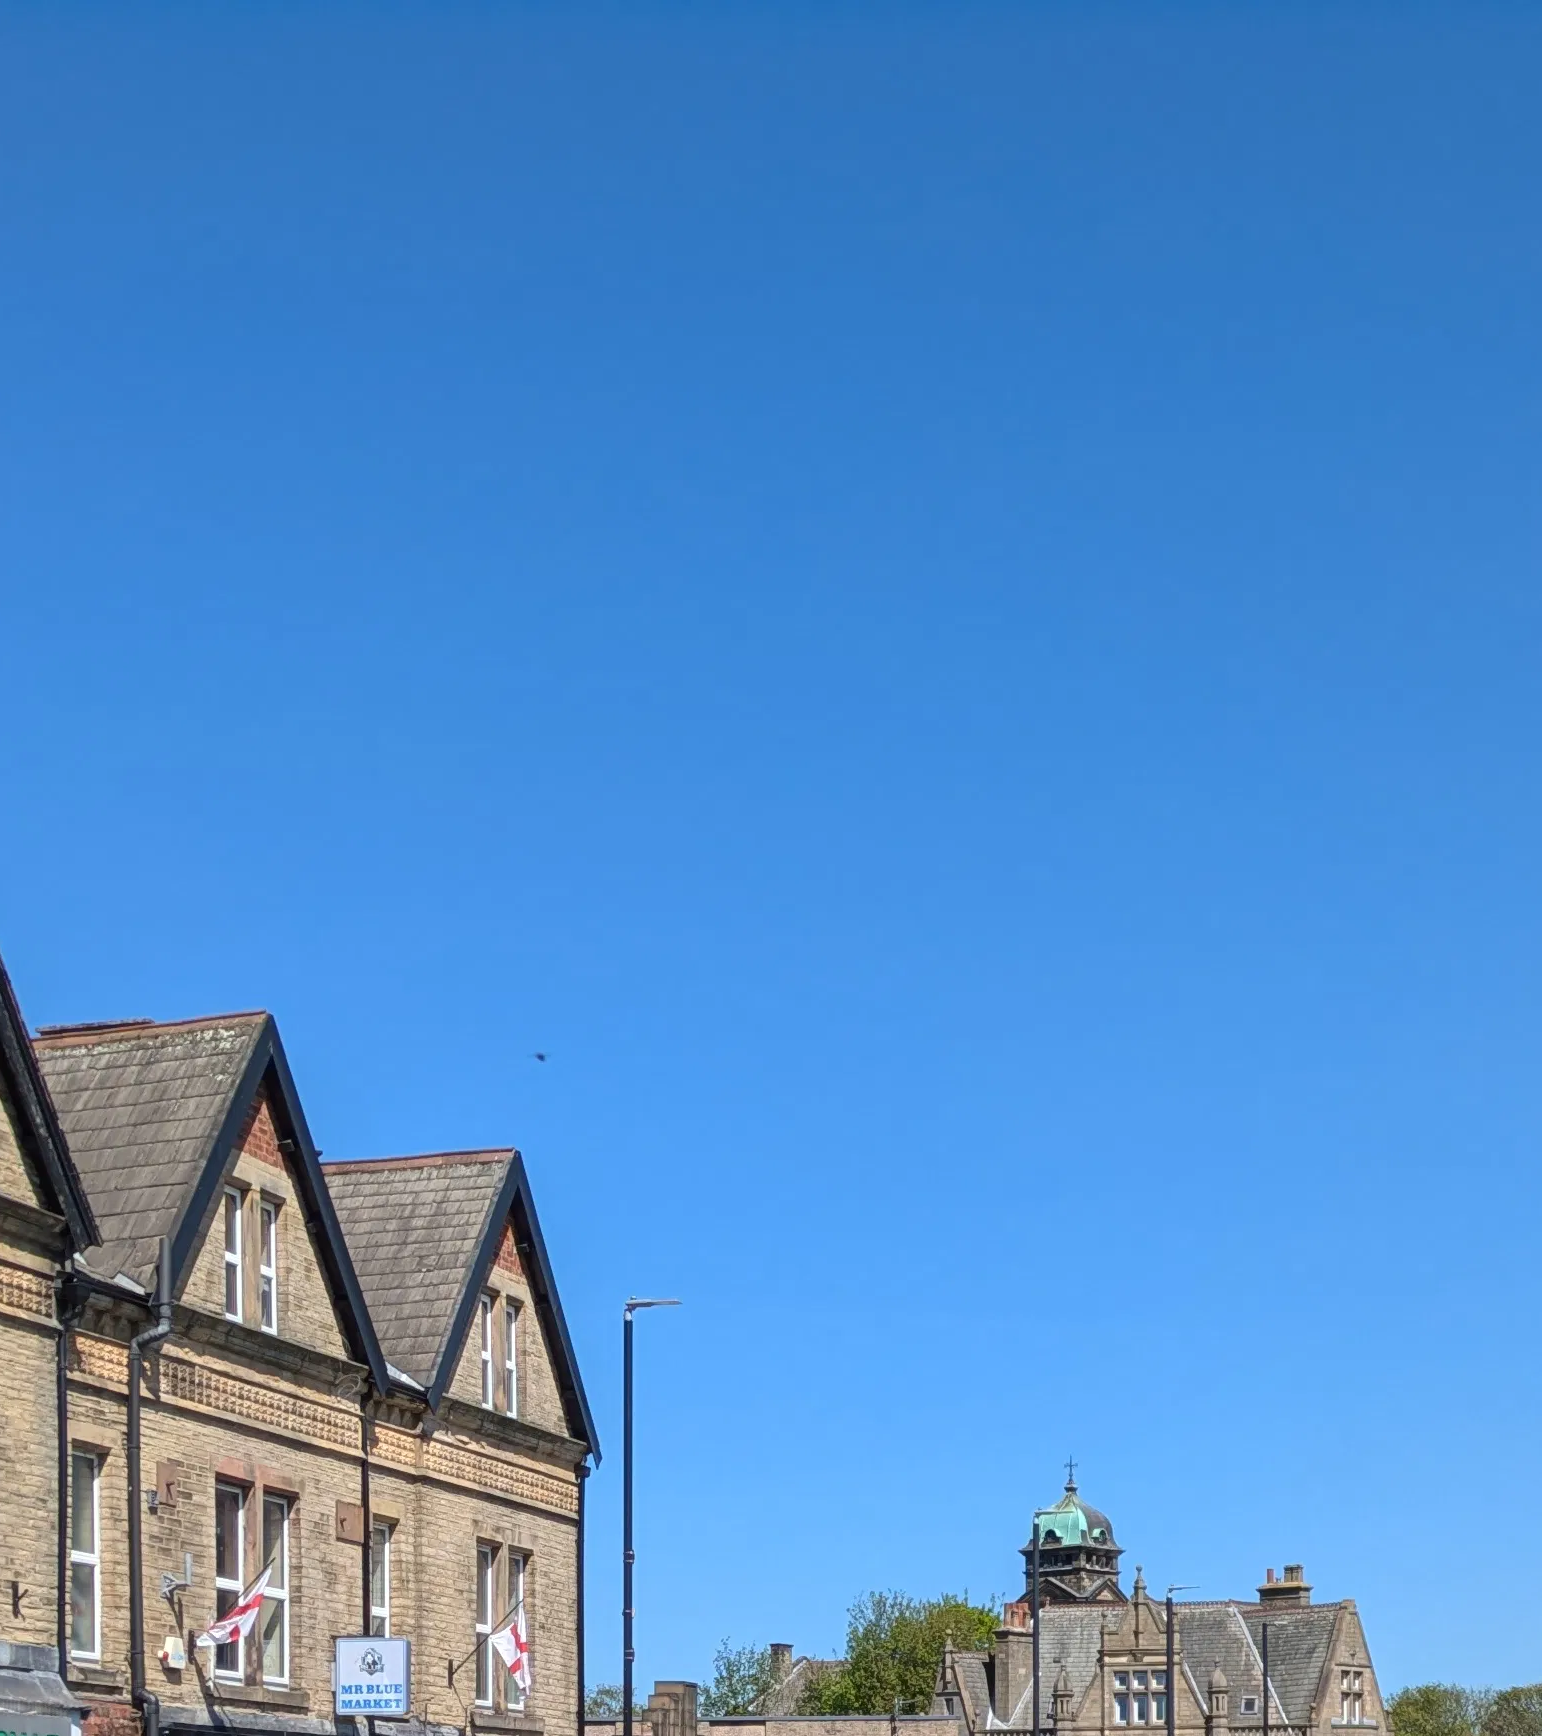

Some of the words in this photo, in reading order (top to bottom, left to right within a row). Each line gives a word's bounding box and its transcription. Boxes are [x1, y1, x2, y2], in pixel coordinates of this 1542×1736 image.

[341, 1684, 364, 1695] MR
[366, 1683, 403, 1695] BLUE
[341, 1699, 403, 1710] MARKET
